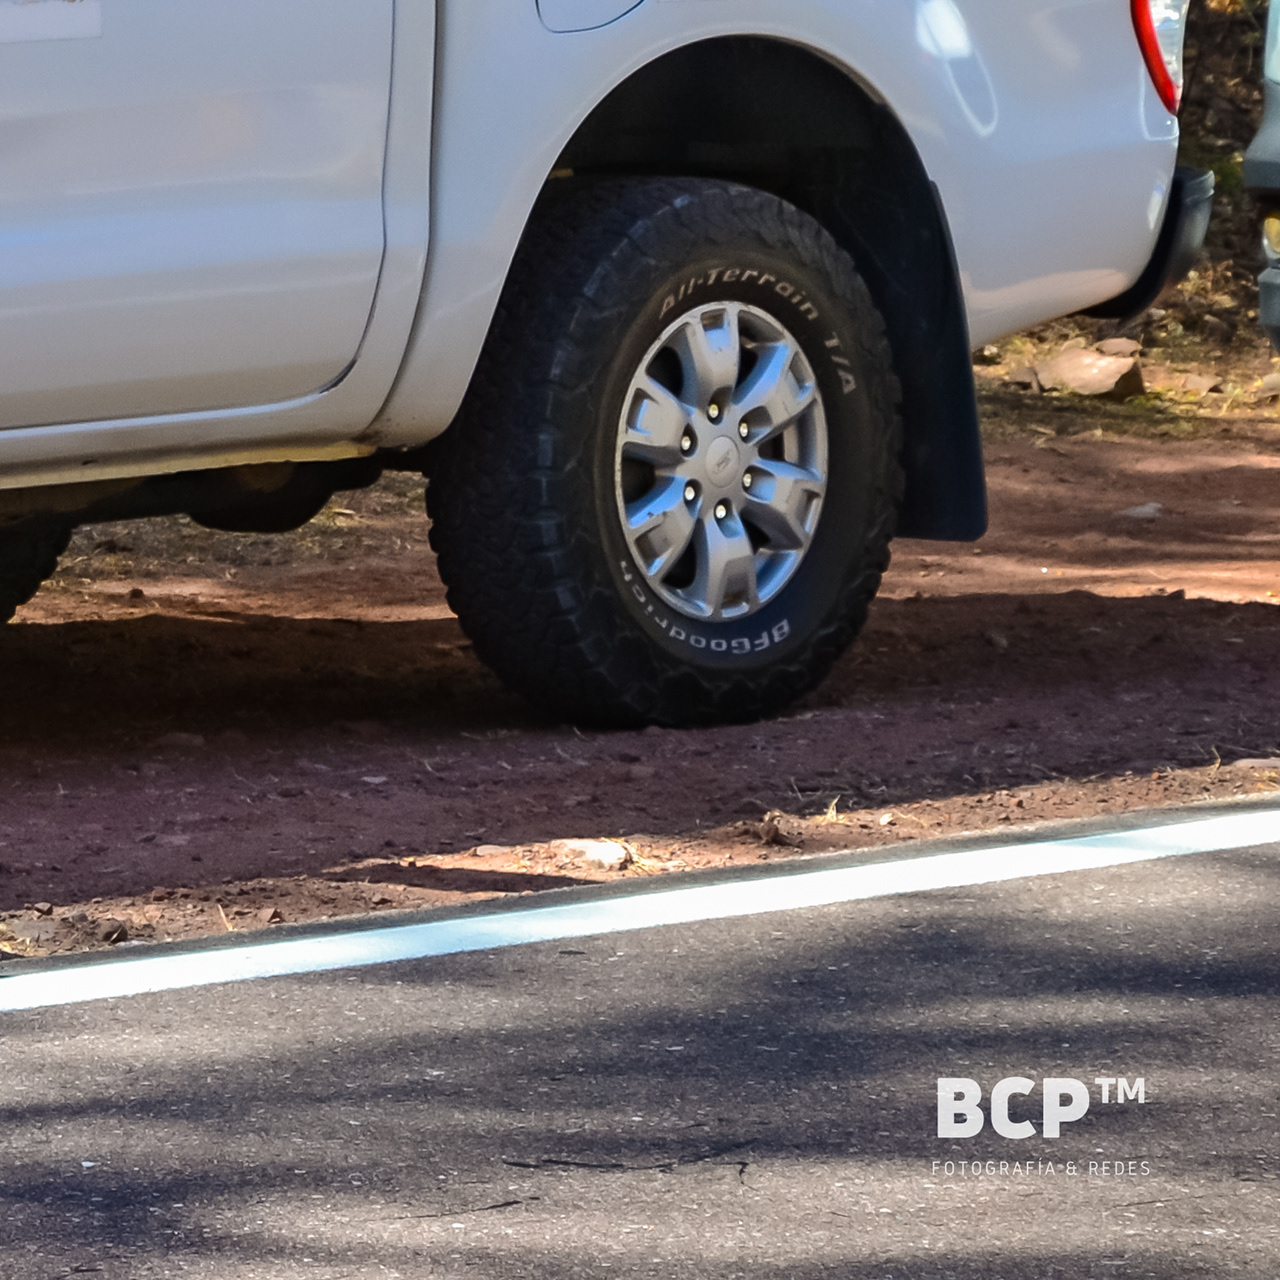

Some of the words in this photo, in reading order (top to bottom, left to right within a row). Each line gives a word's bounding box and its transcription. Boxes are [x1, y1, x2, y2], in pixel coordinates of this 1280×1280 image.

[659, 267, 819, 320] All-Terrain
[824, 331, 857, 395] T/A
[620, 561, 791, 654] BFGoodrich
